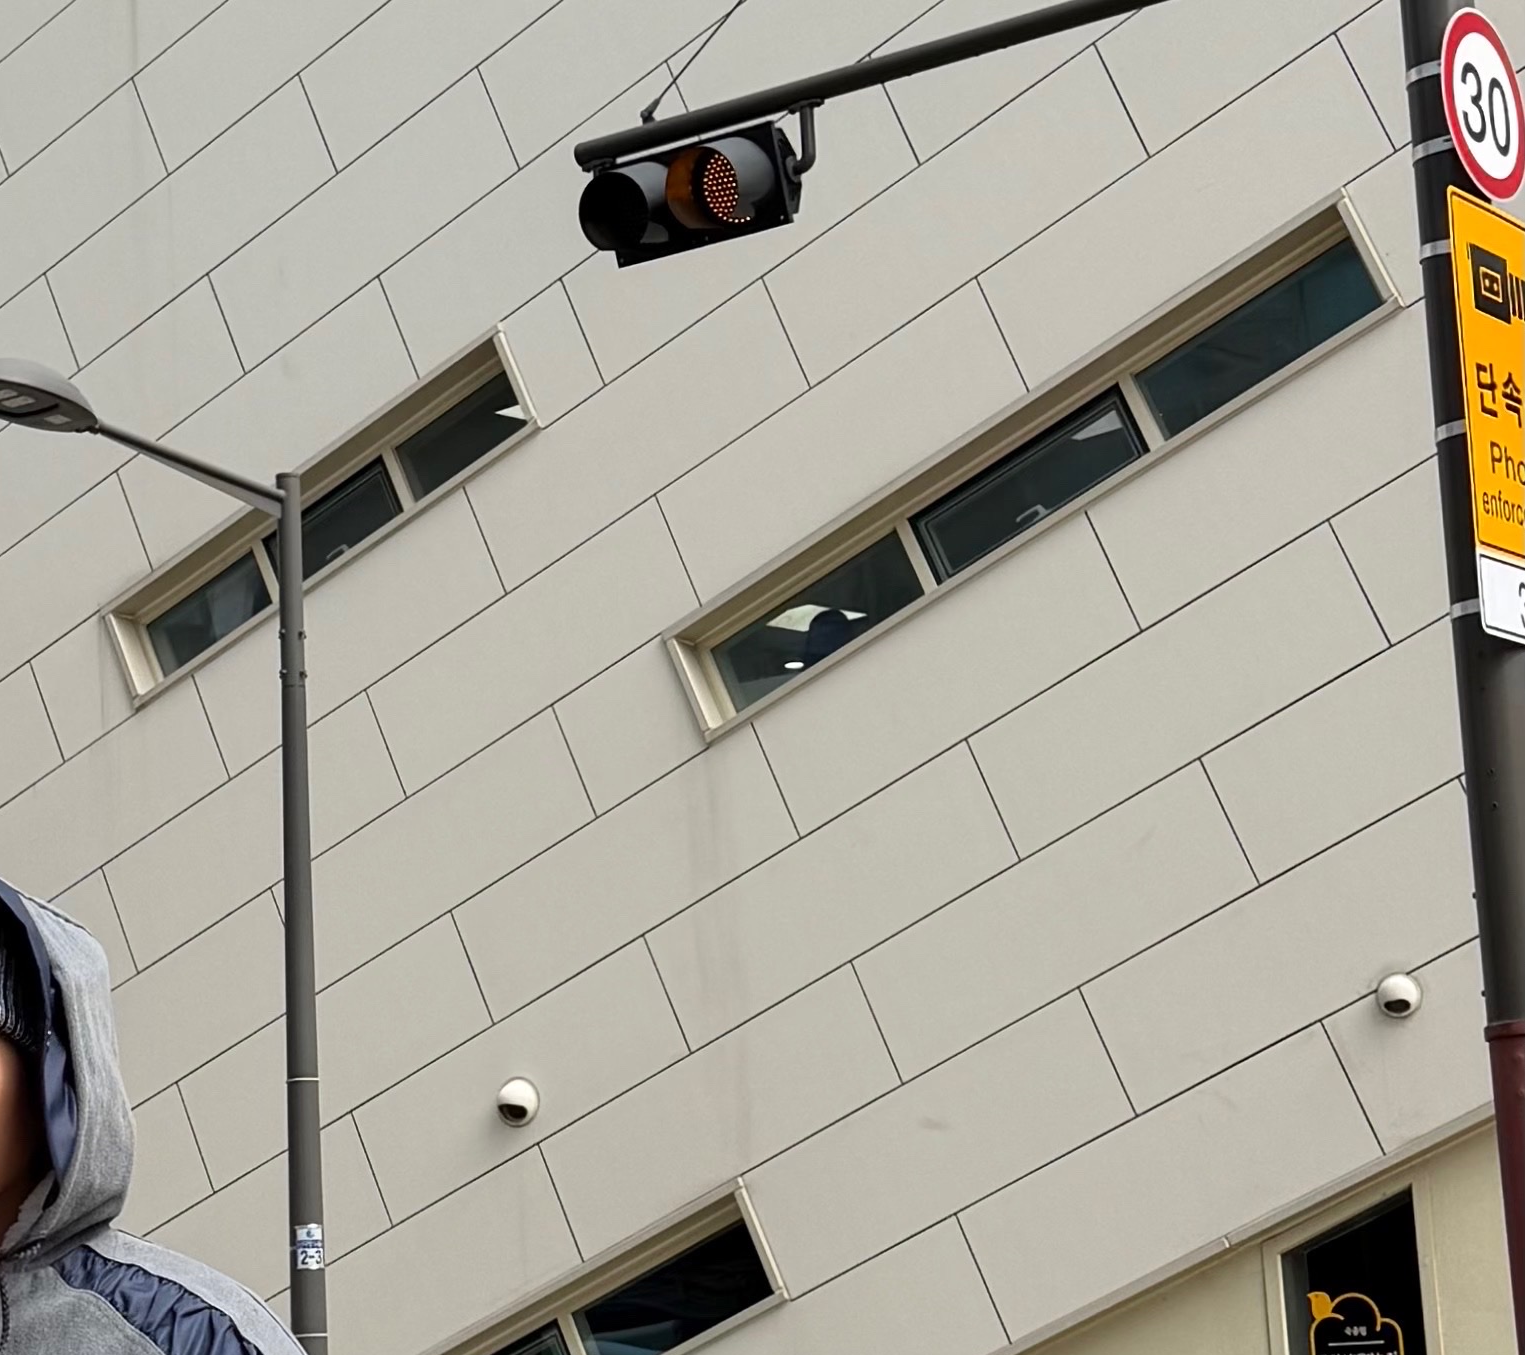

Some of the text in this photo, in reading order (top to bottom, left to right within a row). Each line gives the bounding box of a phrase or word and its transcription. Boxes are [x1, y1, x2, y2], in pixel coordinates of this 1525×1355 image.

[1461, 62, 1510, 157] 30
[1475, 362, 1522, 428] 단속
[1482, 490, 1525, 526] enforc
[300, 1250, 322, 1265] 2-3
